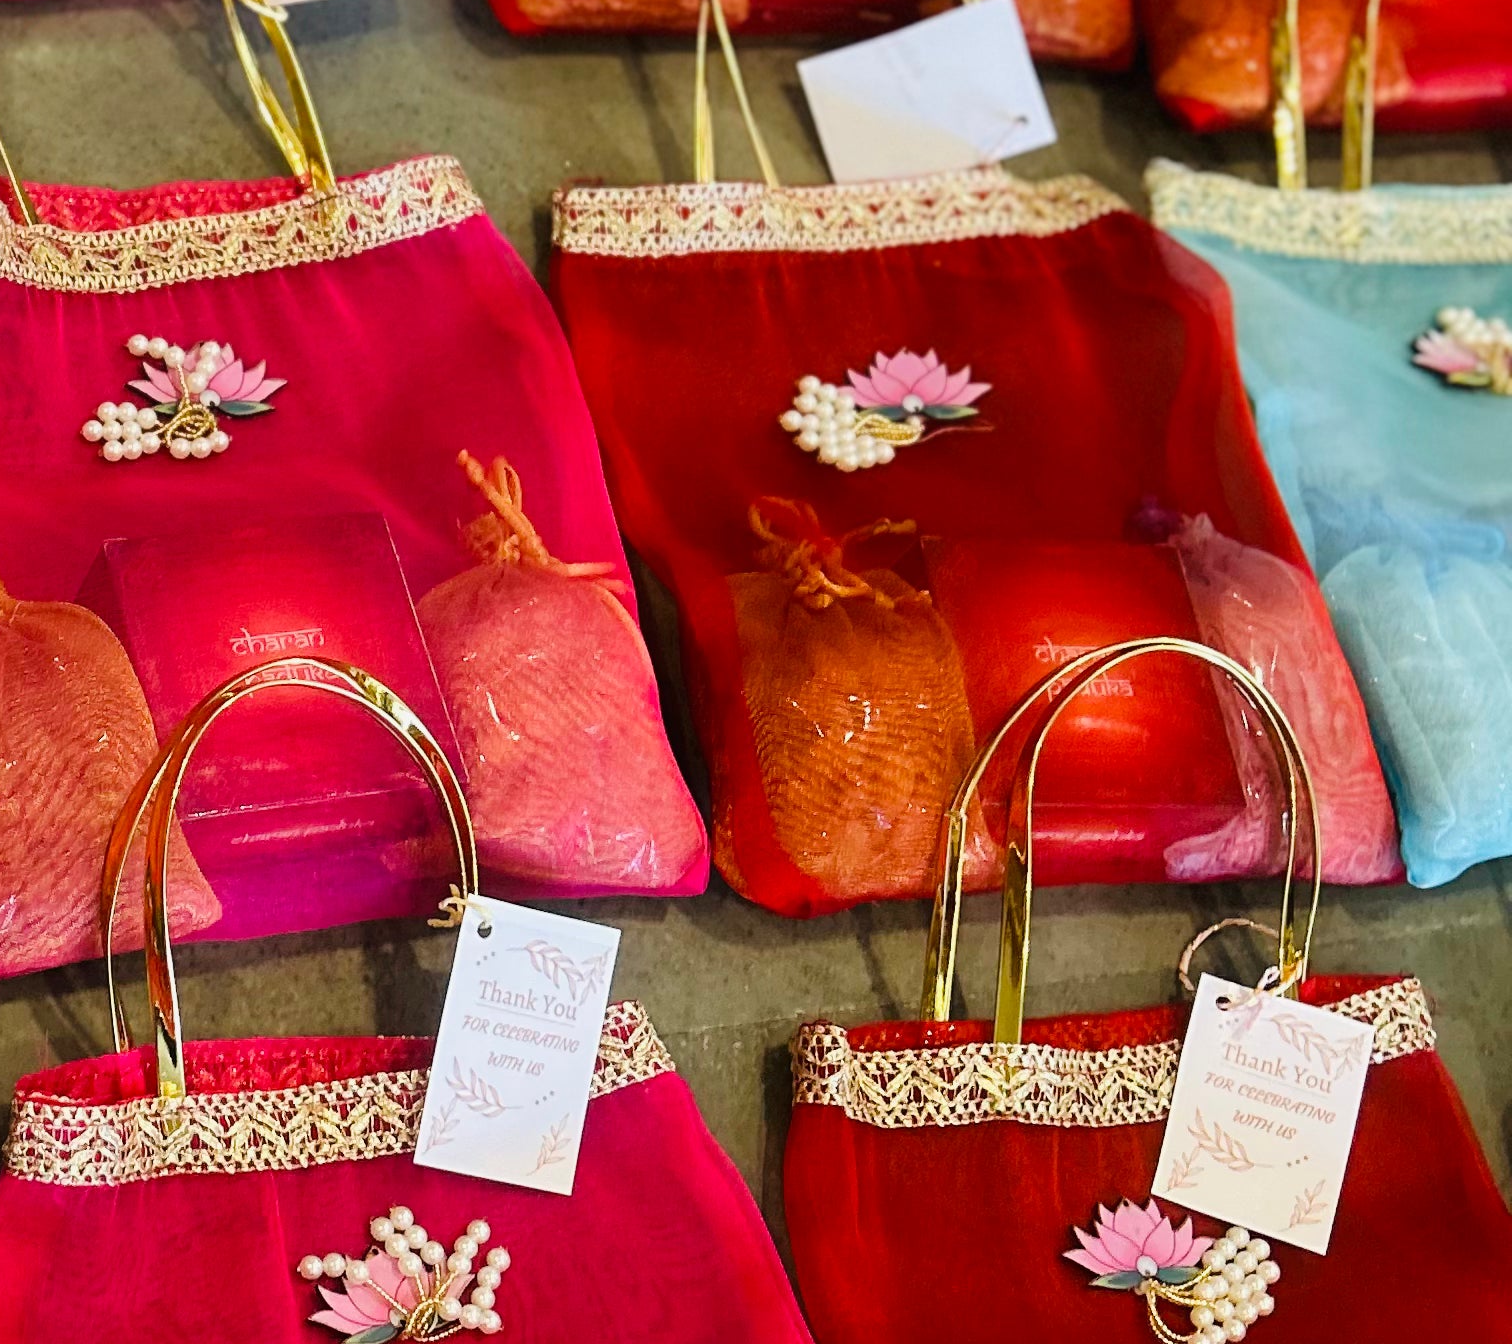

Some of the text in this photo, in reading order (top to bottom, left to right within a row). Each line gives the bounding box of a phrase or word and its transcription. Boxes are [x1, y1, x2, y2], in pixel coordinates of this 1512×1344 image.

[229, 627, 326, 656] charan
[478, 980, 578, 1022] Thank You
[461, 1014, 580, 1054] FOR CELEBRATING
[488, 1051, 545, 1077] WITH US
[1222, 1041, 1333, 1094] Thank You
[1203, 1071, 1337, 1125] FOR CELEBRATING
[1232, 1108, 1298, 1141] WITH US
